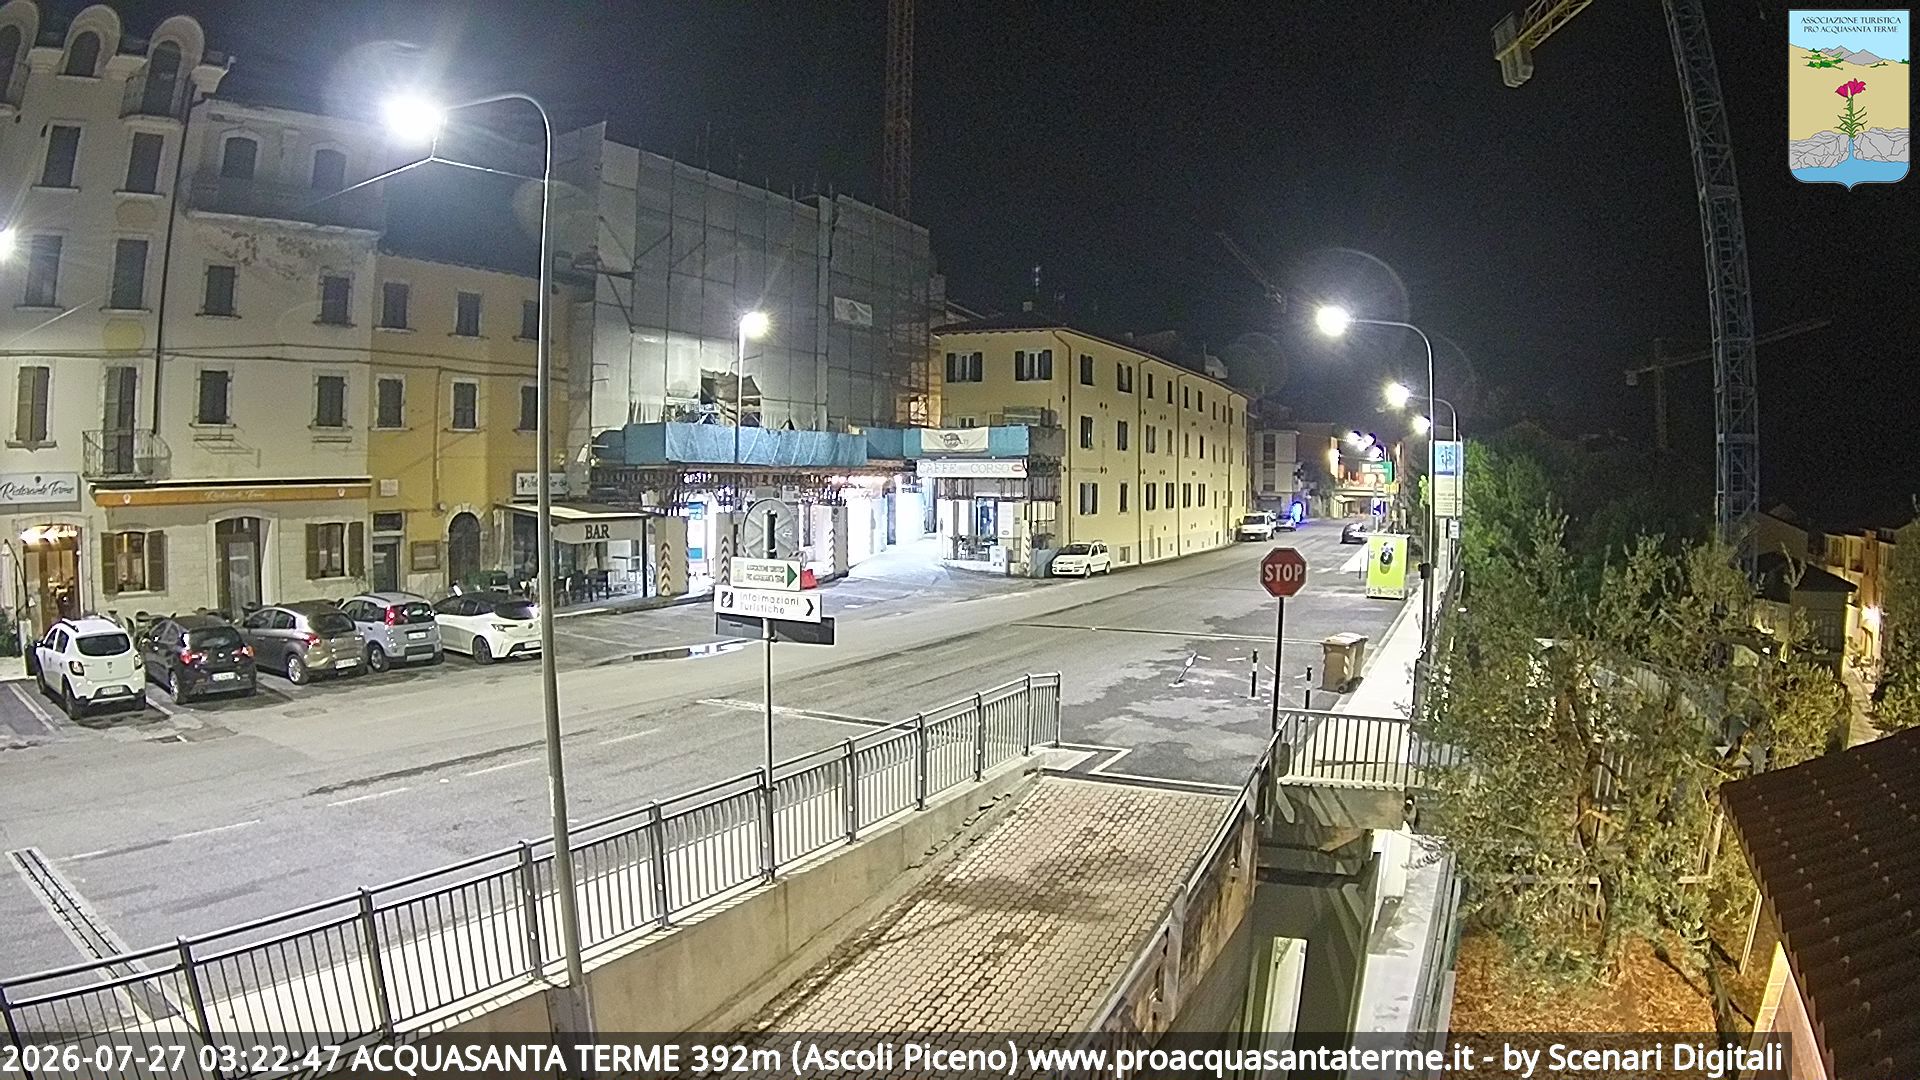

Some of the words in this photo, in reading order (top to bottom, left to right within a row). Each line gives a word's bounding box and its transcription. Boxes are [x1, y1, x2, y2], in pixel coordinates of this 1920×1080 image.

[970, 463, 1011, 474] CORSO
[585, 524, 610, 540] BAR
[1264, 563, 1303, 582] STOP
[739, 592, 799, 606] Informazioni
